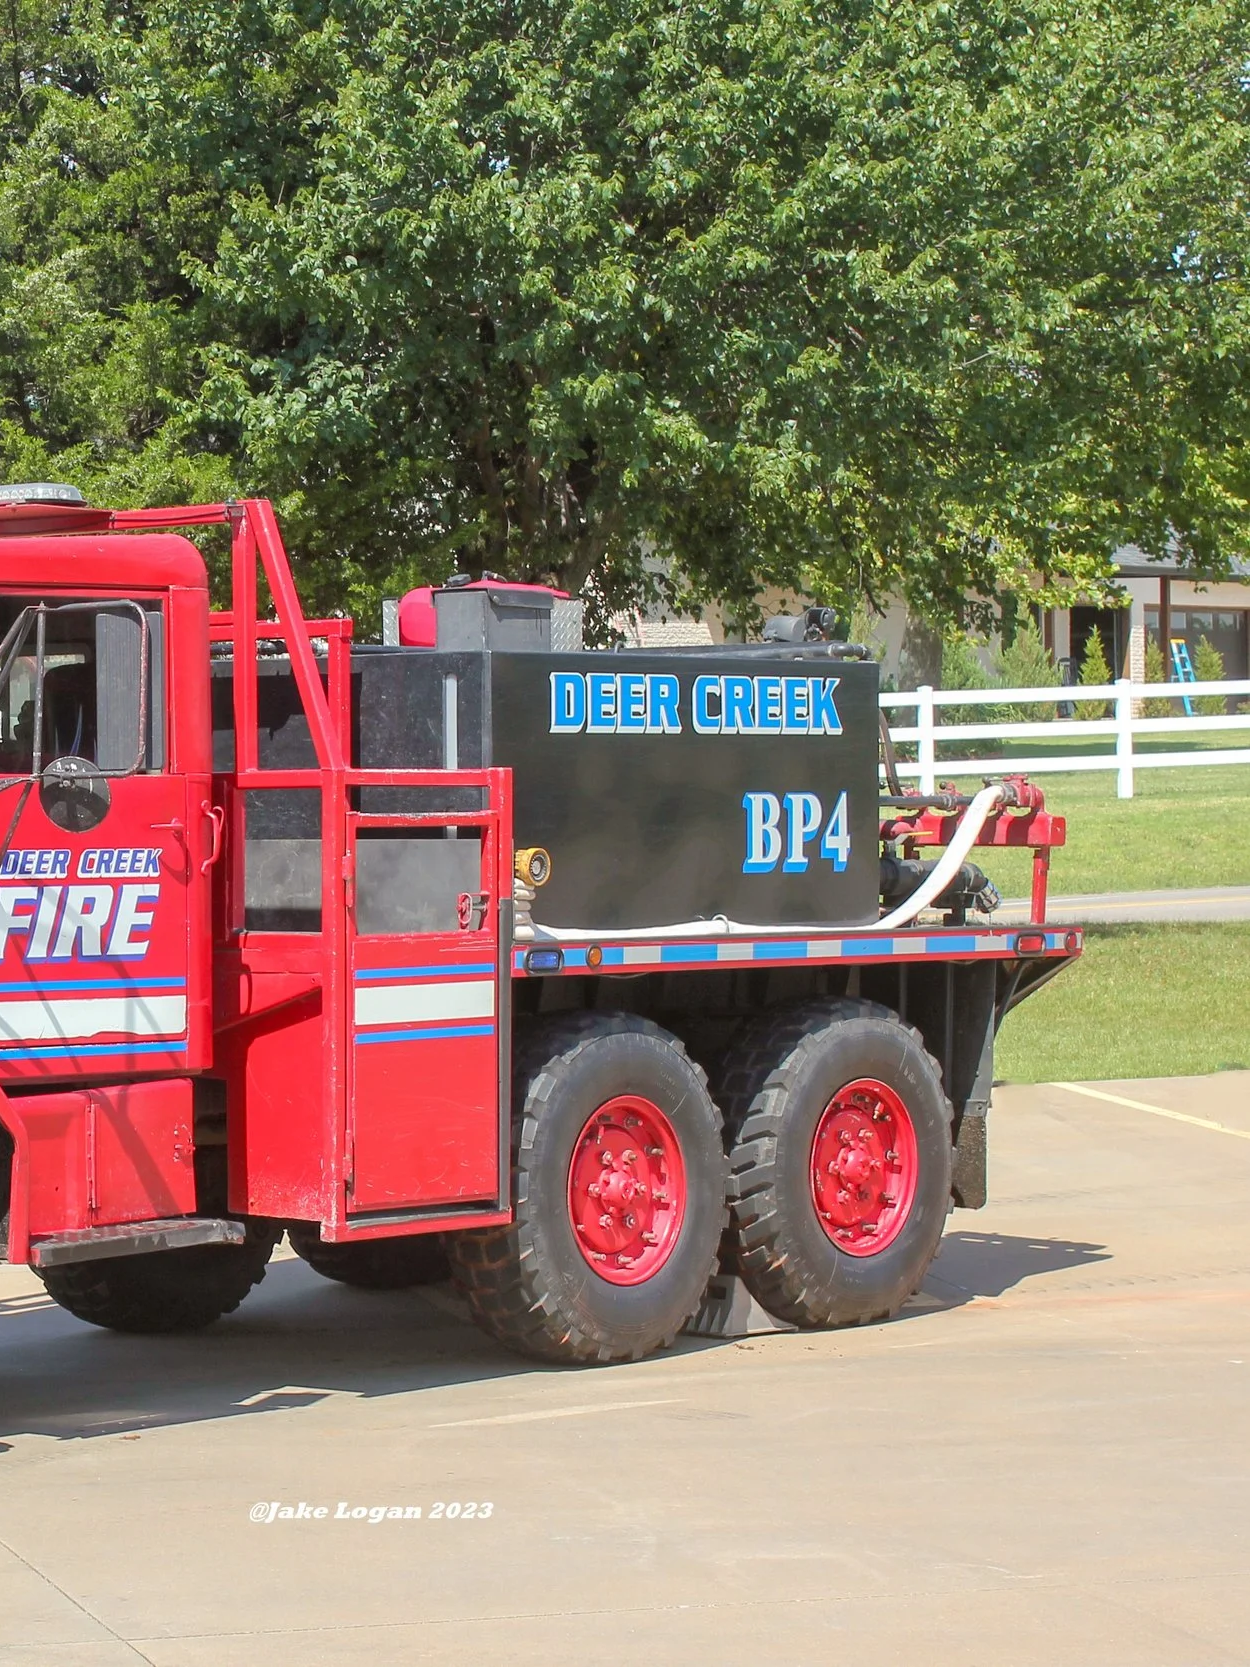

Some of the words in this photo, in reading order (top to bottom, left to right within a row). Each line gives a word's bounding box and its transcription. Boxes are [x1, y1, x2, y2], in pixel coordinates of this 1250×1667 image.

[549, 672, 682, 734] DEER
[692, 675, 843, 735] CREEK
[742, 789, 851, 873] BP4
[77, 848, 162, 878] CREEK
